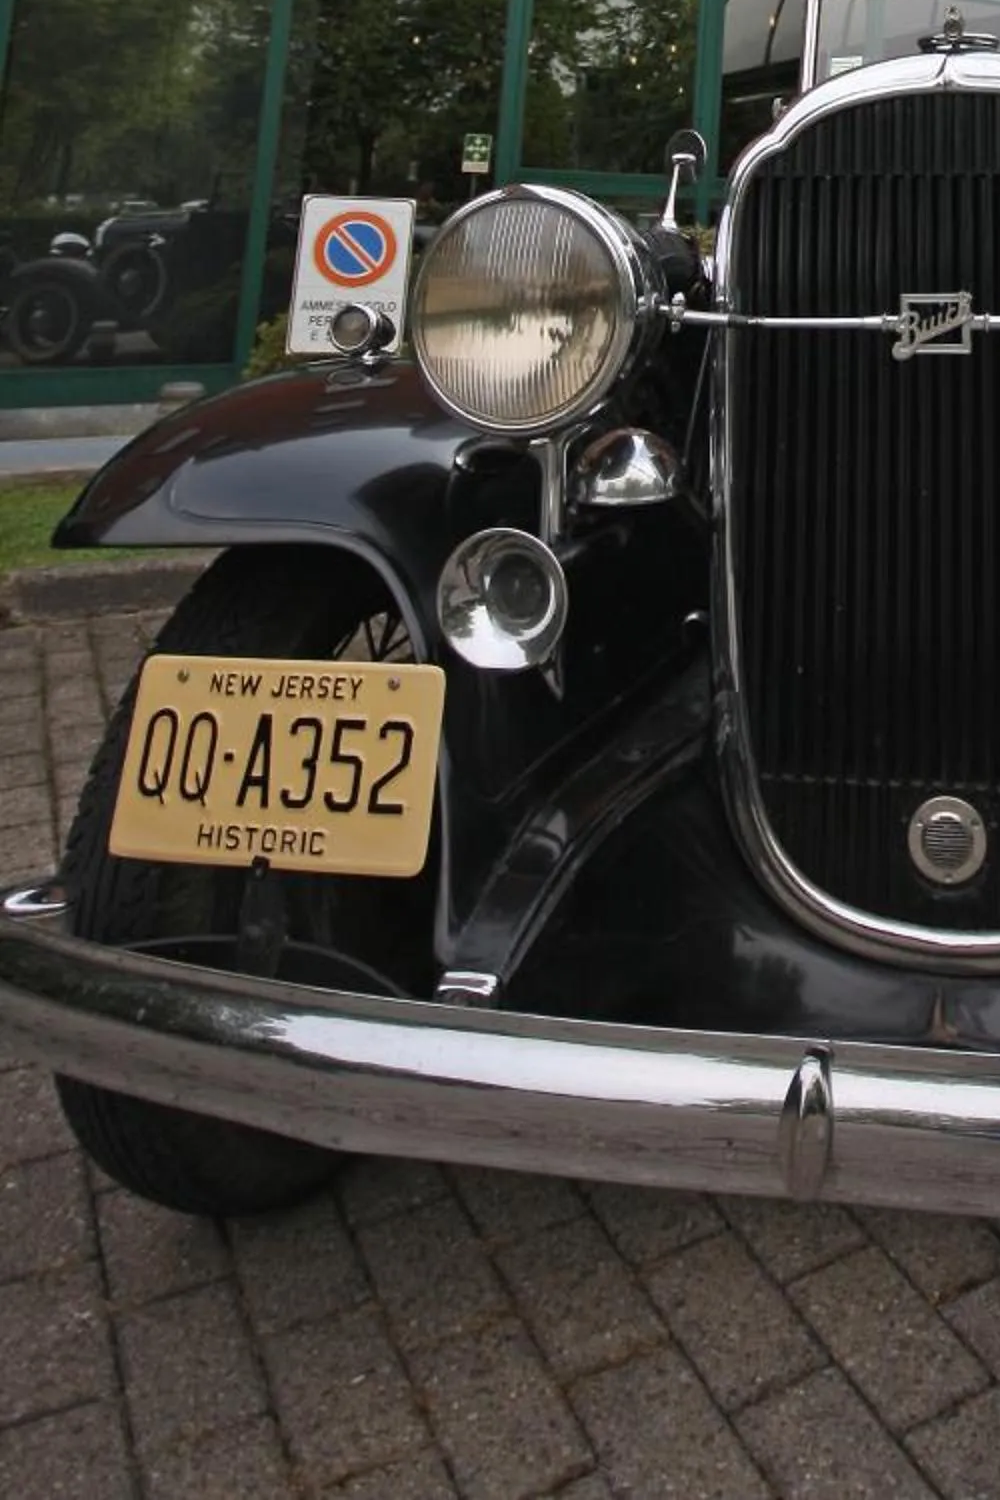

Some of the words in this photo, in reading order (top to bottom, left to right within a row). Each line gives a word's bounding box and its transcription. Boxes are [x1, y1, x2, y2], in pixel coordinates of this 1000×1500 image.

[209, 671, 263, 698] NEW
[270, 674, 364, 700] JERSEY
[196, 823, 326, 856] HISTORIC
